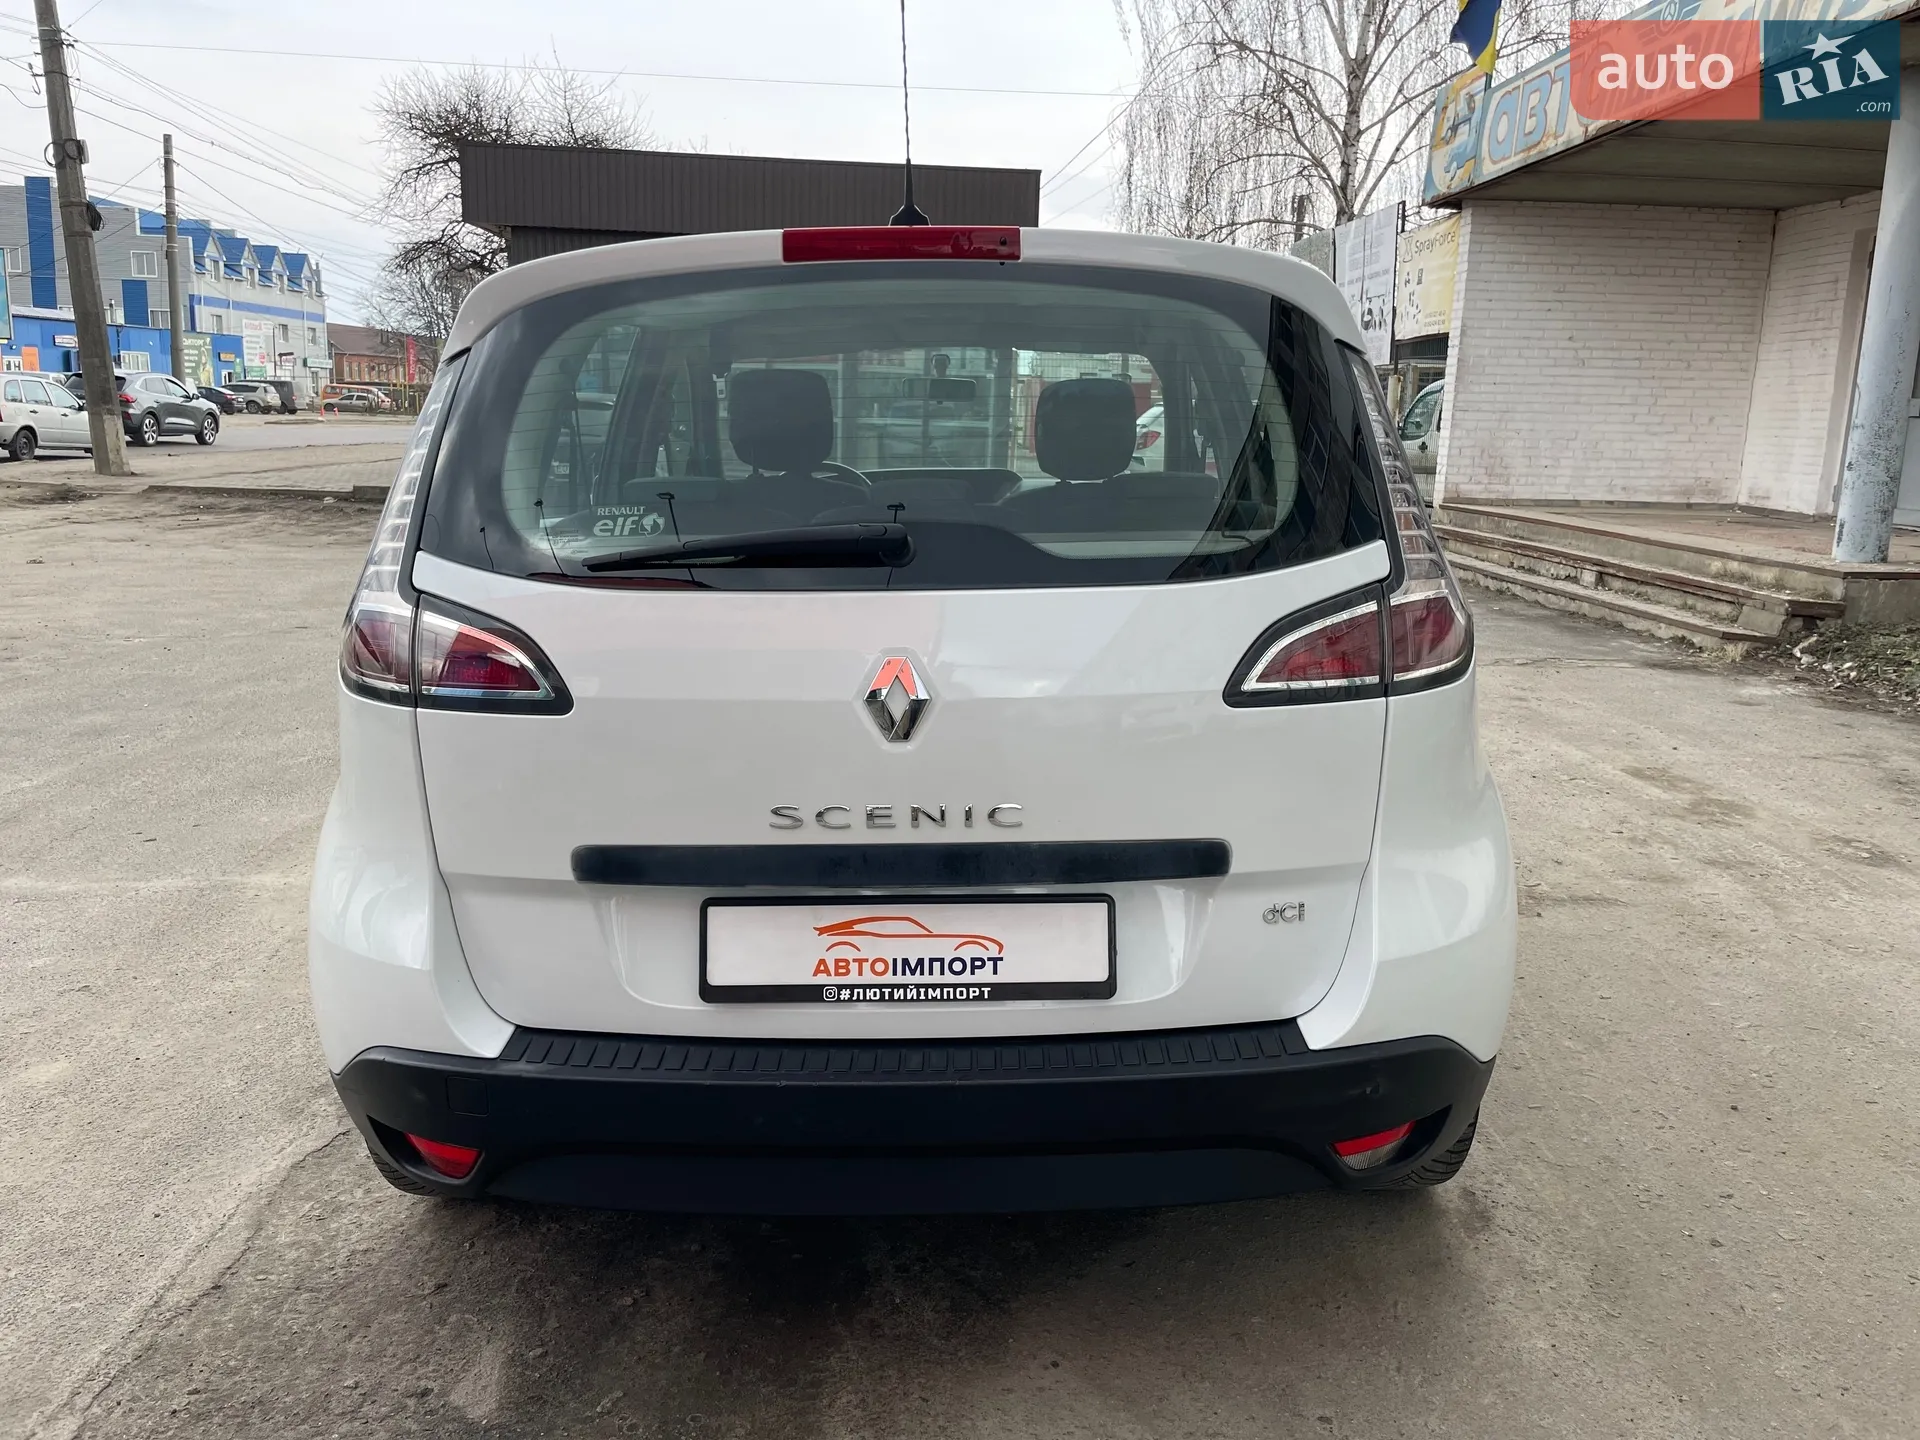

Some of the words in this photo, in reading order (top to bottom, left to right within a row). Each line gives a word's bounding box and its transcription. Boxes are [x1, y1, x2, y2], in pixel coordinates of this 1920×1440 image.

[1414, 231, 1456, 256] SprayForce
[597, 506, 645, 516] RENAULT
[593, 516, 639, 537] elf
[769, 803, 1024, 830] SCENIC
[812, 957, 1004, 978] АВТОІМПОРТ
